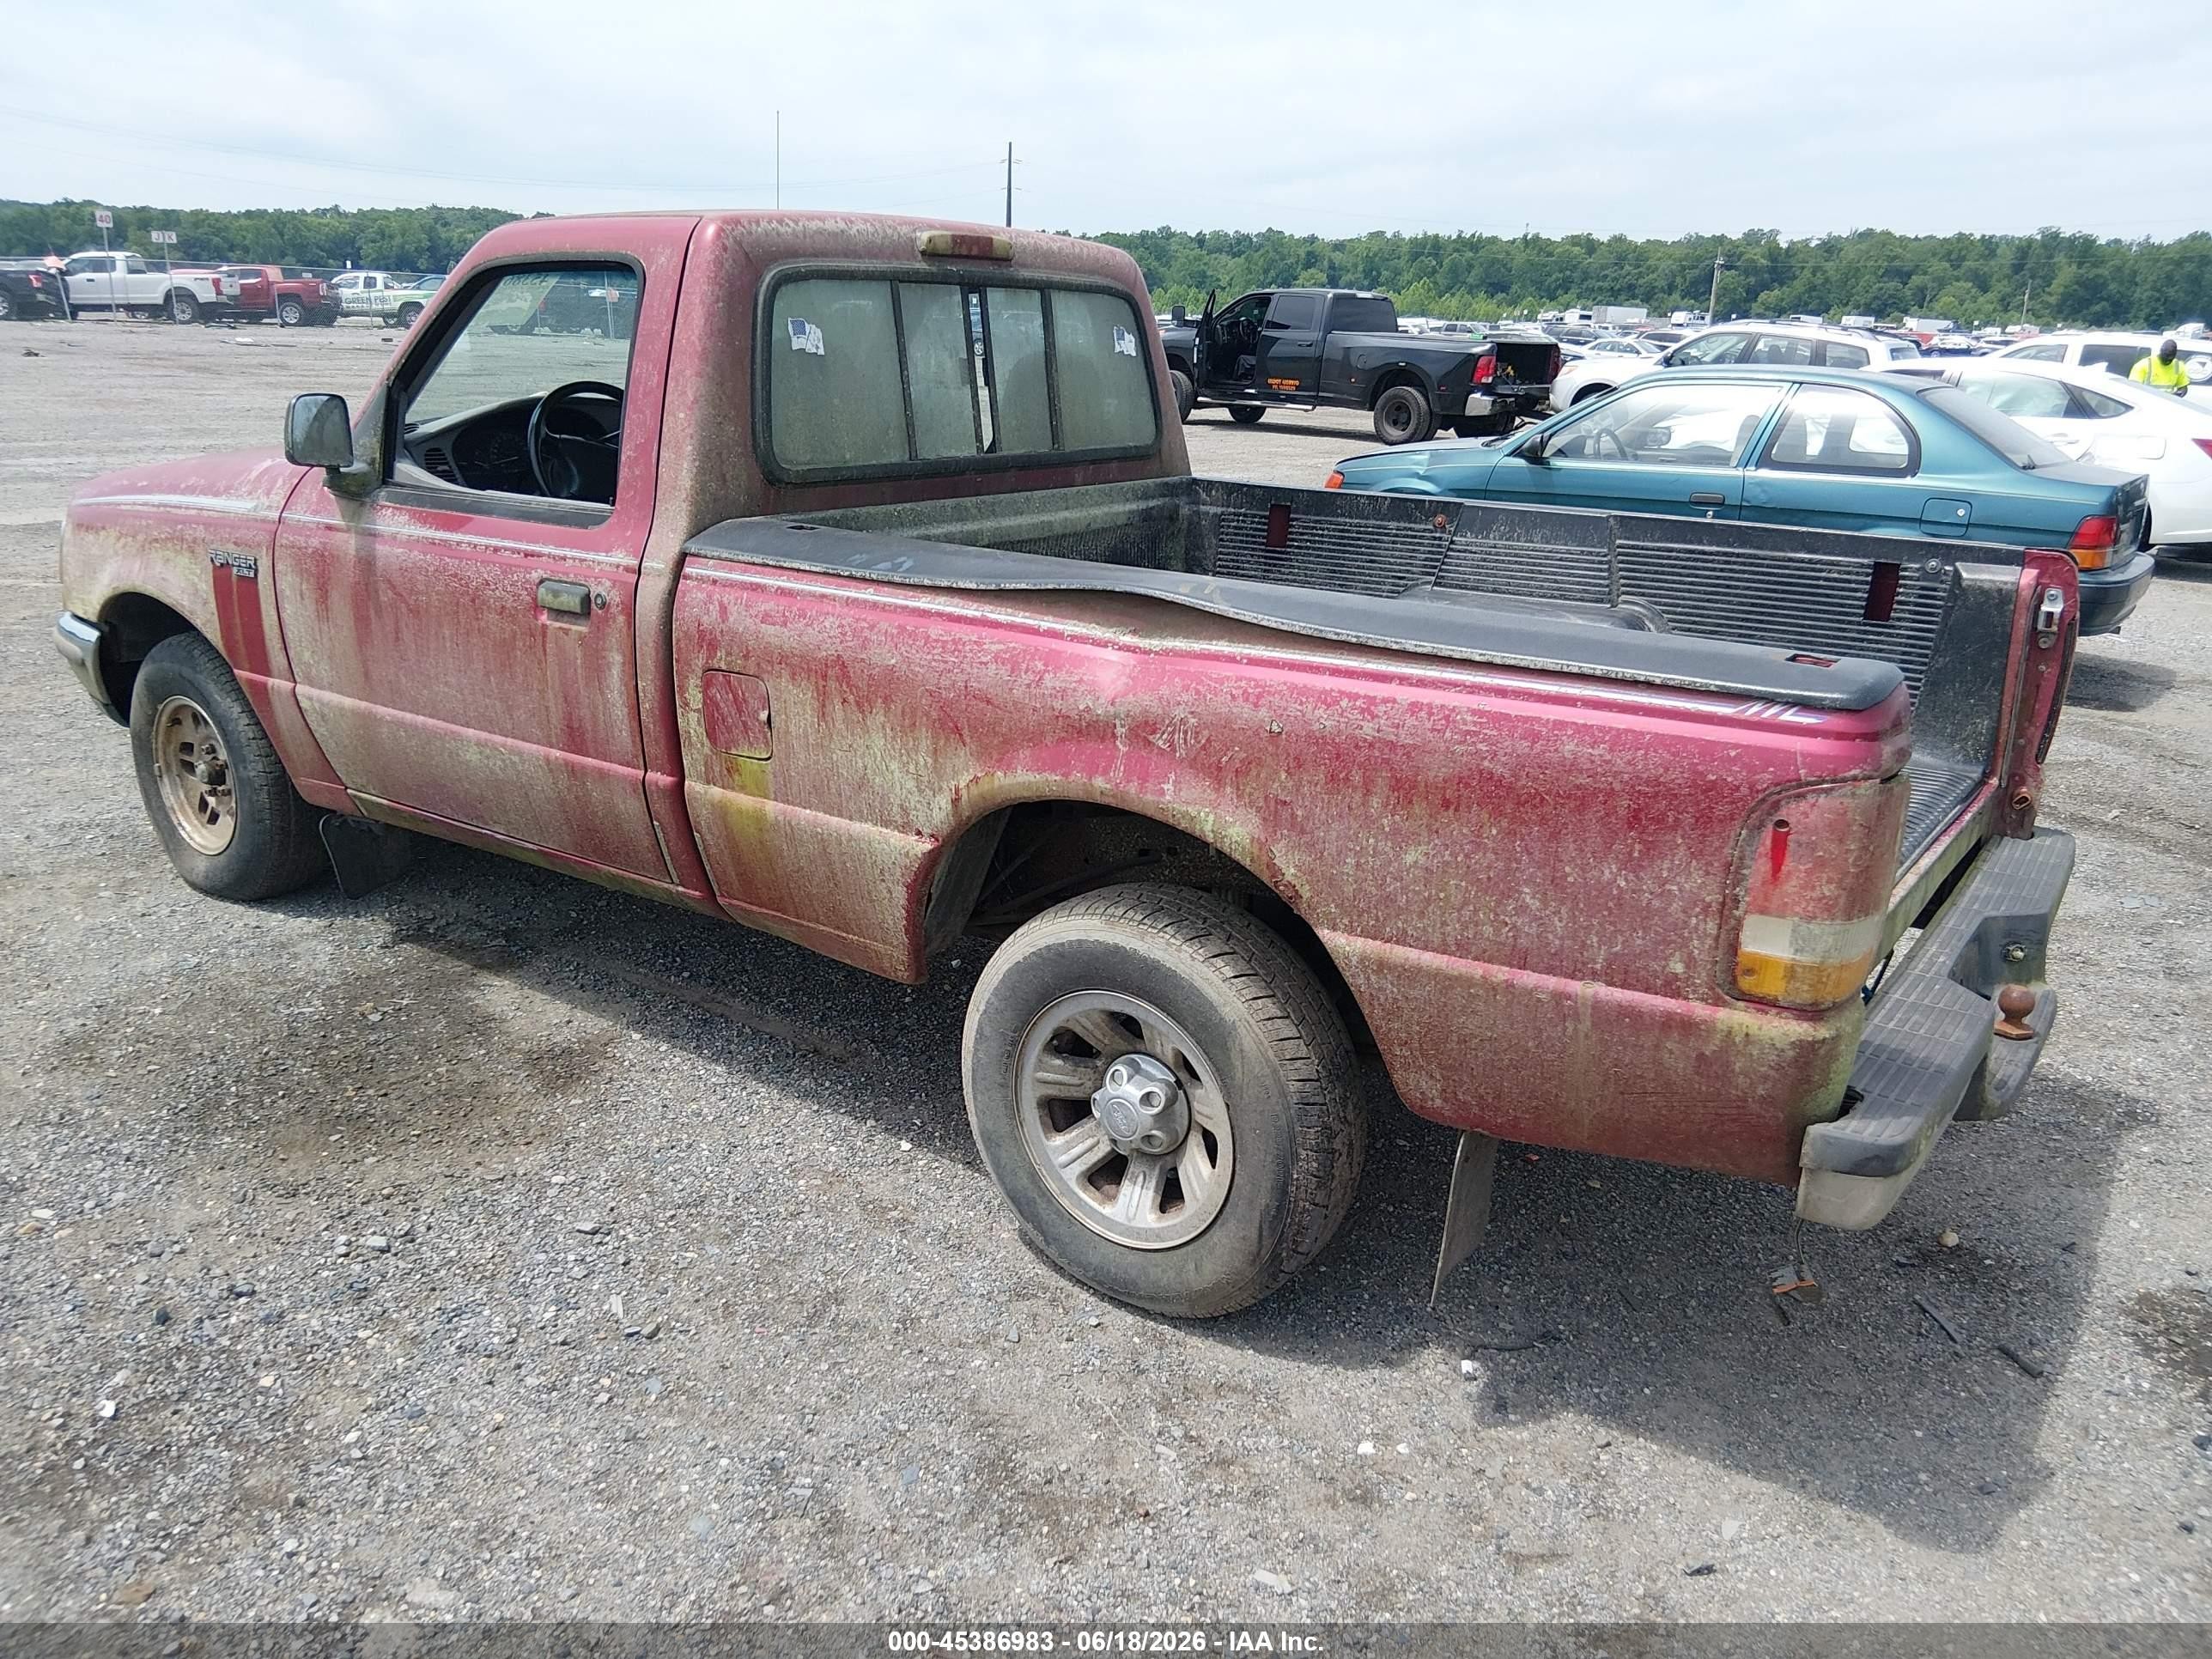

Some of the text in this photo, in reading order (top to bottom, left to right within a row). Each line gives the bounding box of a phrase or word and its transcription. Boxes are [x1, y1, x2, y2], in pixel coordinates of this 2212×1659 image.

[98, 214, 111, 224] 40
[155, 233, 174, 241] J K
[344, 295, 392, 305] GREEN PEST
[207, 549, 257, 568] RANGER
